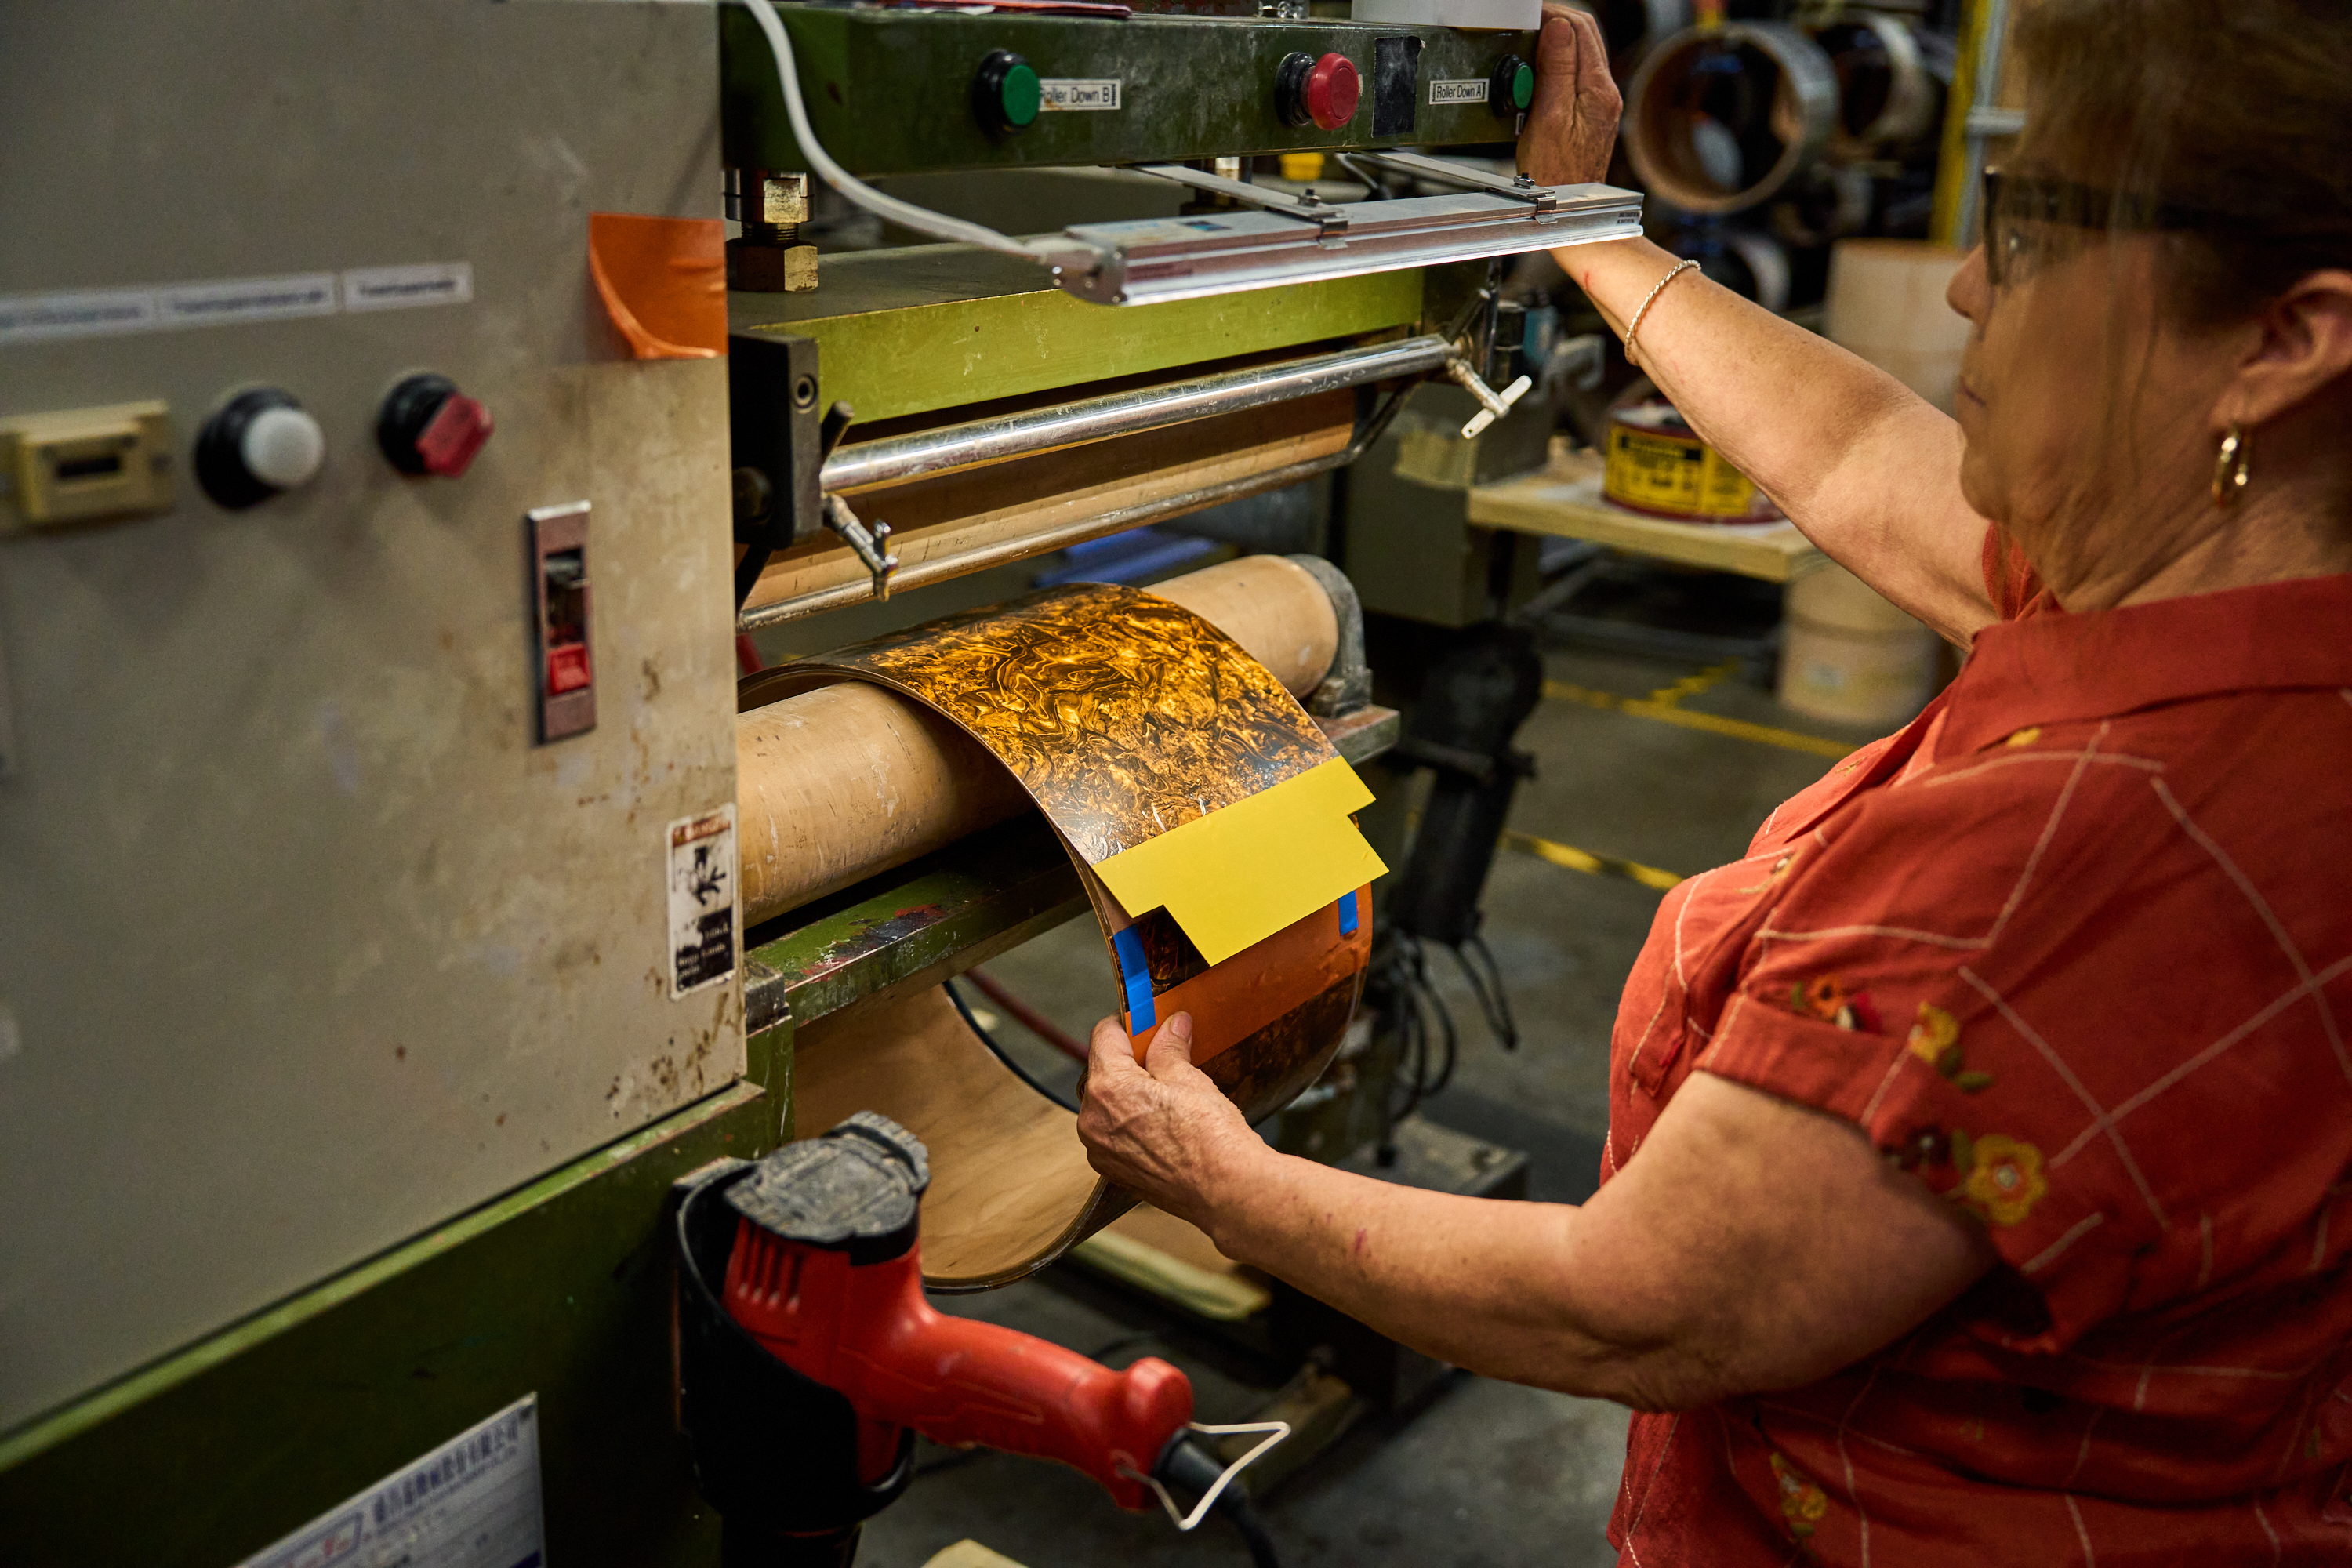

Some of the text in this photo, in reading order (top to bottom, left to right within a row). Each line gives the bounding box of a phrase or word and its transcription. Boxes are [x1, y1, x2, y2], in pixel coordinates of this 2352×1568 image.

[1071, 86, 1099, 103] Down
[1102, 86, 1110, 103] B
[1437, 84, 1482, 99] Roller Down A
